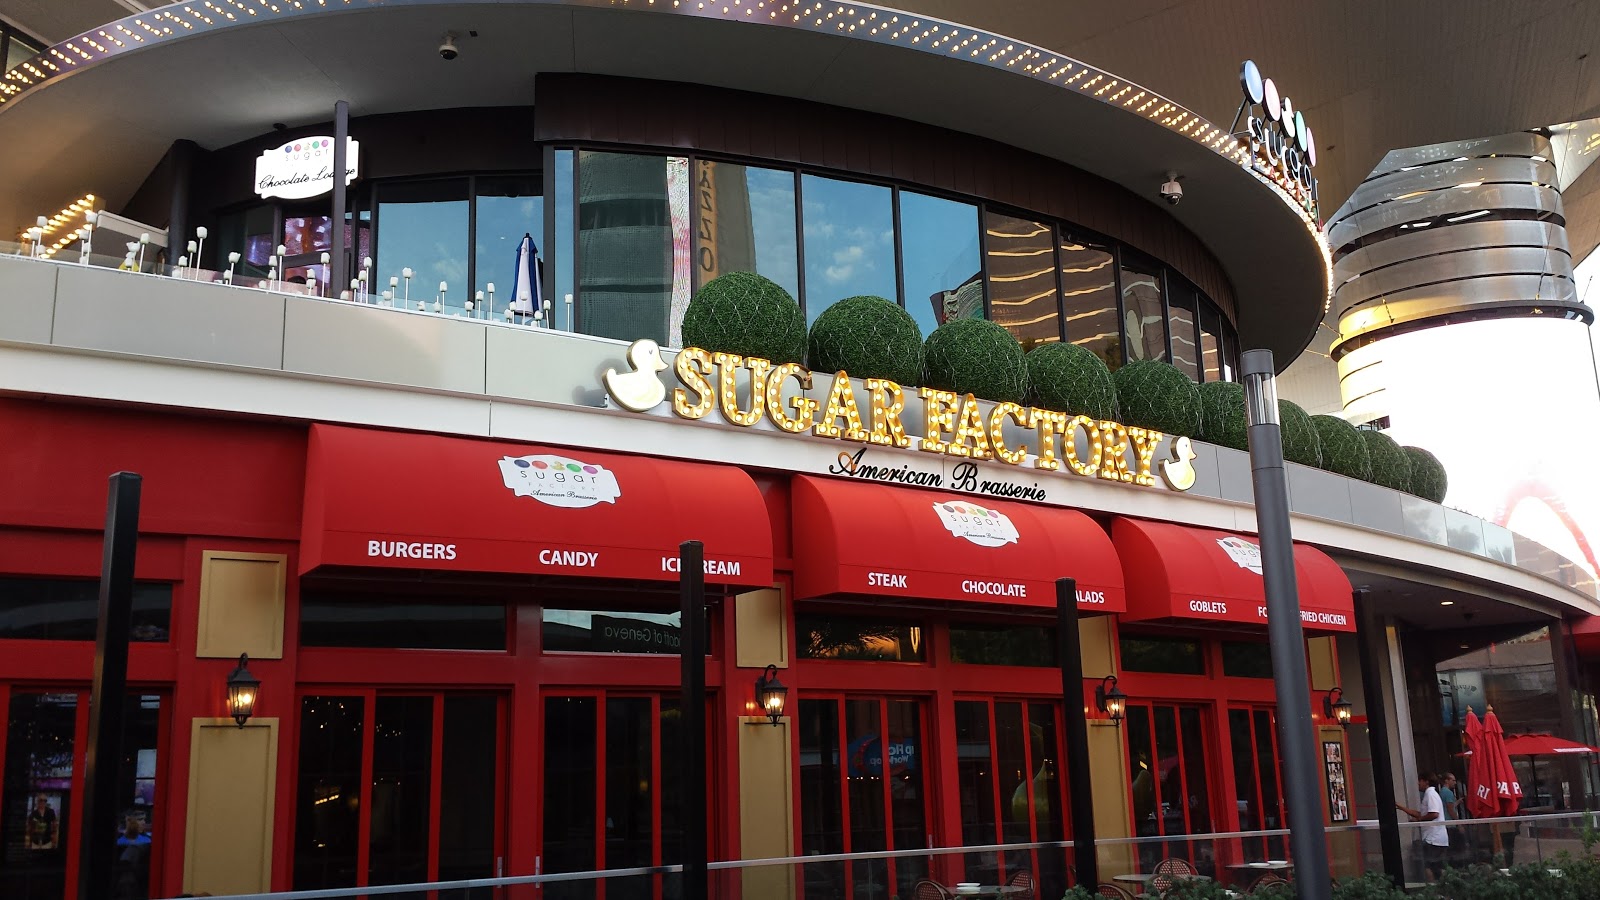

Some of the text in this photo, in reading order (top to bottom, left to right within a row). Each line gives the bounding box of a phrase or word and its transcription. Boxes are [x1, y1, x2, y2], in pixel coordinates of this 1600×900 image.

[258, 172, 310, 190] Chocolate
[672, 346, 1163, 487] SUGAR FACTORY
[520, 470, 596, 483] sugar
[829, 447, 1046, 501] American Brasserie
[530, 488, 566, 498] American
[951, 514, 1001, 526] sugar
[367, 540, 457, 560] BURGERS
[539, 549, 599, 567] CANDY
[703, 559, 741, 576] REAM
[868, 572, 908, 589] STEAK
[961, 580, 1027, 597] CHOCOLATE
[1075, 590, 1105, 604] ALADS
[1189, 600, 1227, 614] GOBLETS
[1318, 613, 1347, 625] CHICKEN
